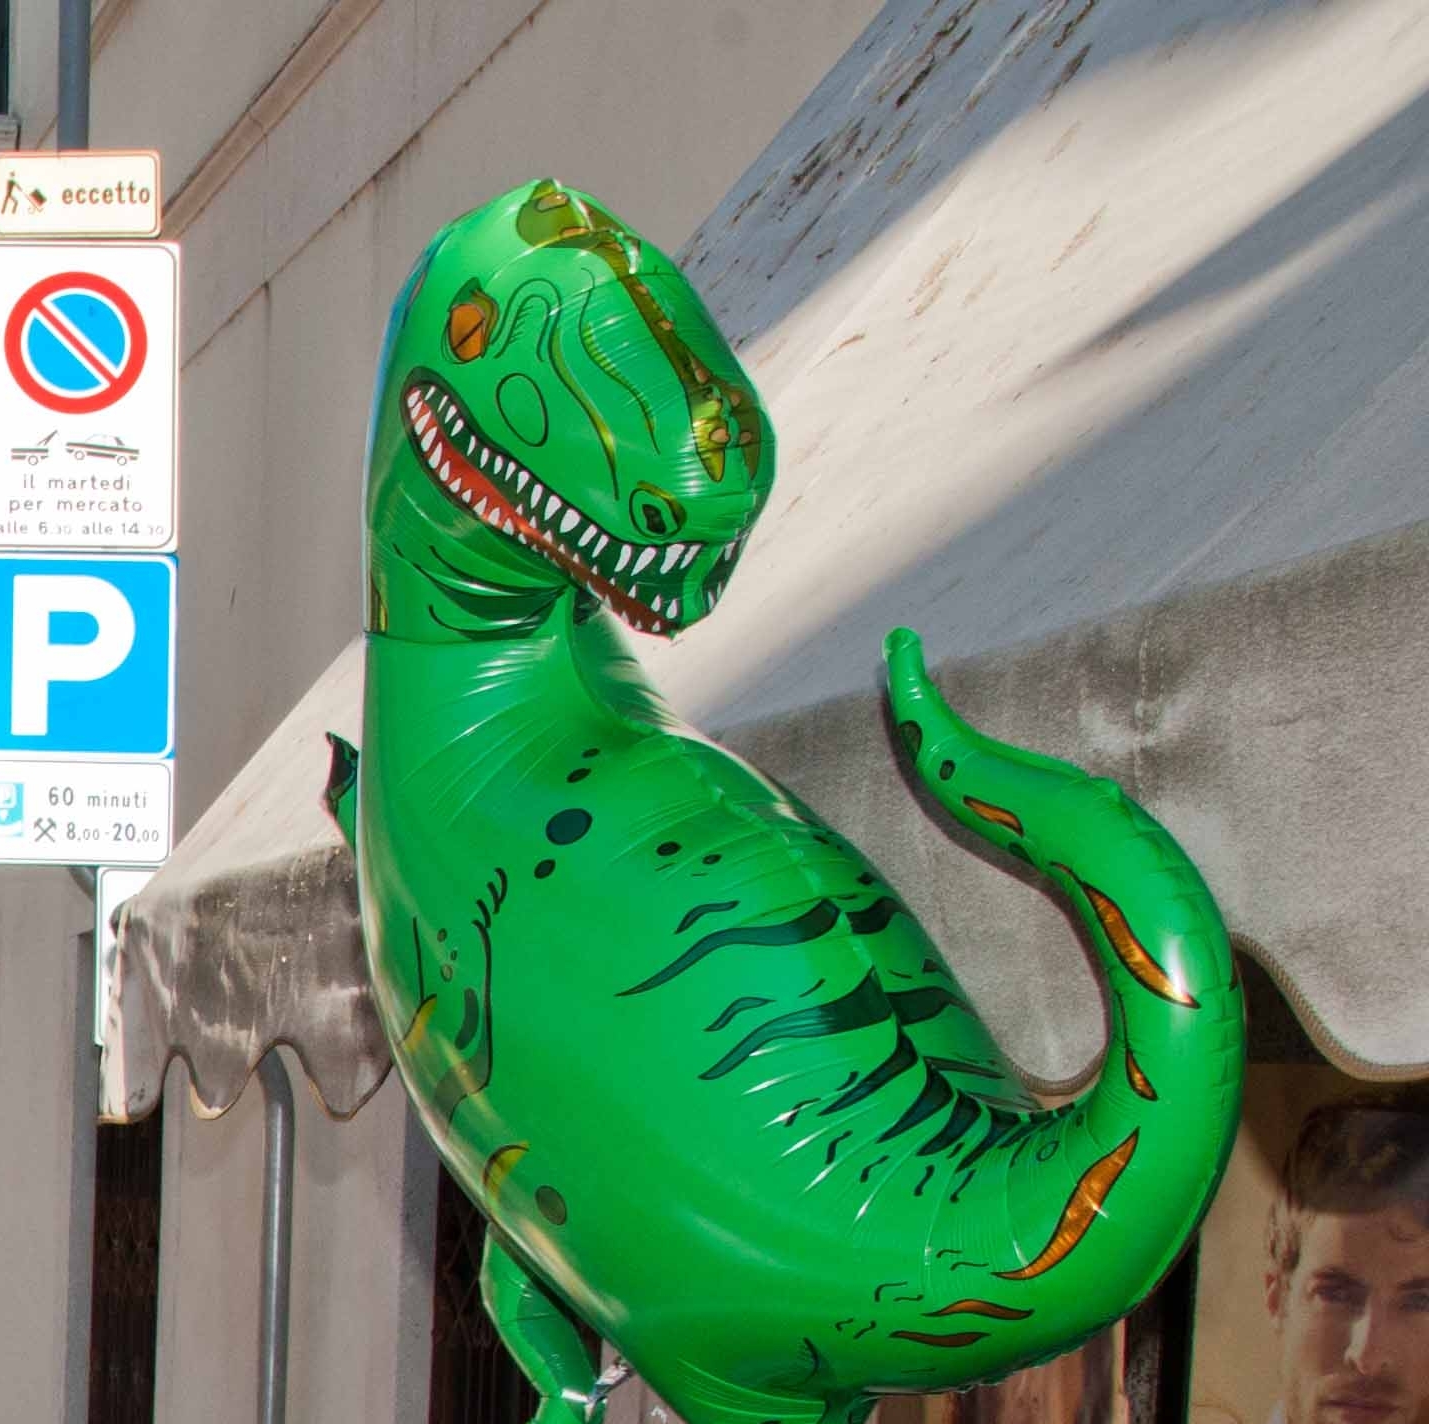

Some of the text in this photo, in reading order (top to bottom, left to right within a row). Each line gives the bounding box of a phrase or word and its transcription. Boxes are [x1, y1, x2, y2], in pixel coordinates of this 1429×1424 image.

[62, 180, 151, 205] eccetto
[22, 473, 36, 489] il
[8, 497, 143, 514] per mercato
[81, 522, 114, 536] alle
[11, 573, 136, 737] P
[48, 786, 147, 809] 60 minuti
